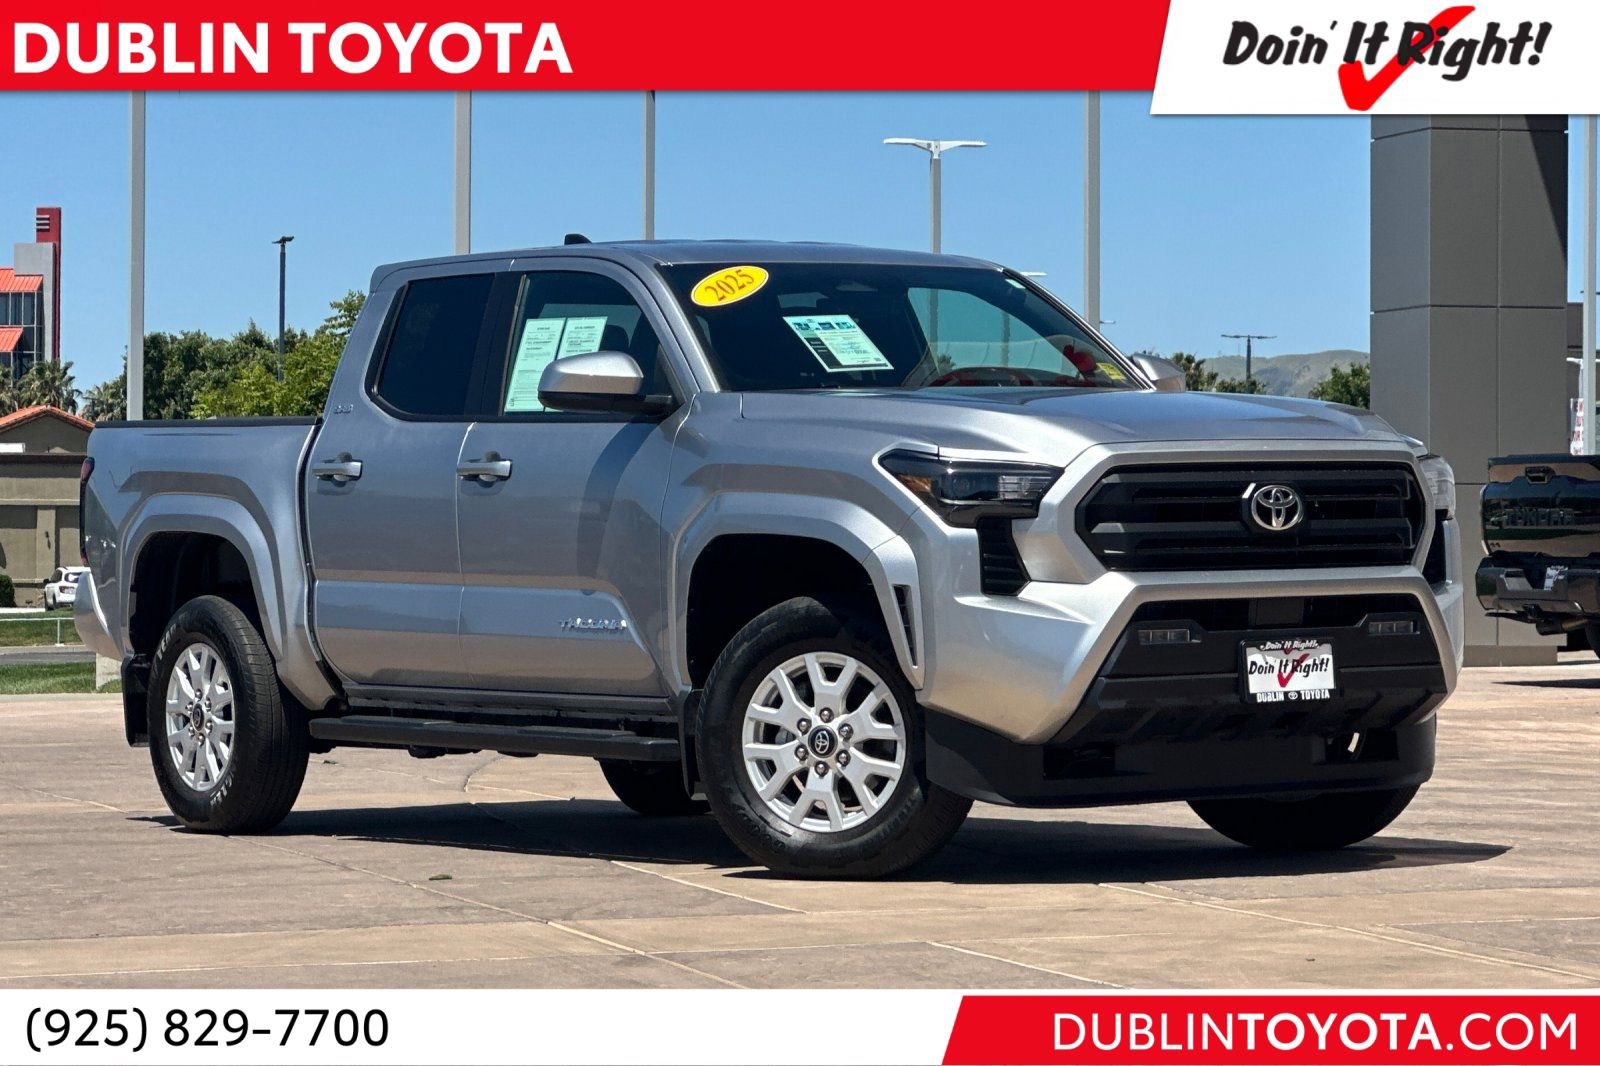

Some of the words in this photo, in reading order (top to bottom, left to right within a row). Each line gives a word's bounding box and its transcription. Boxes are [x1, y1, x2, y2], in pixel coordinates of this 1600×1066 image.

[704, 268, 755, 302] 2025
[1279, 659, 1289, 673] It
[1291, 657, 1330, 678] Right!
[1256, 691, 1285, 703] DUBLIN
[1300, 689, 1330, 700] TOYOTA
